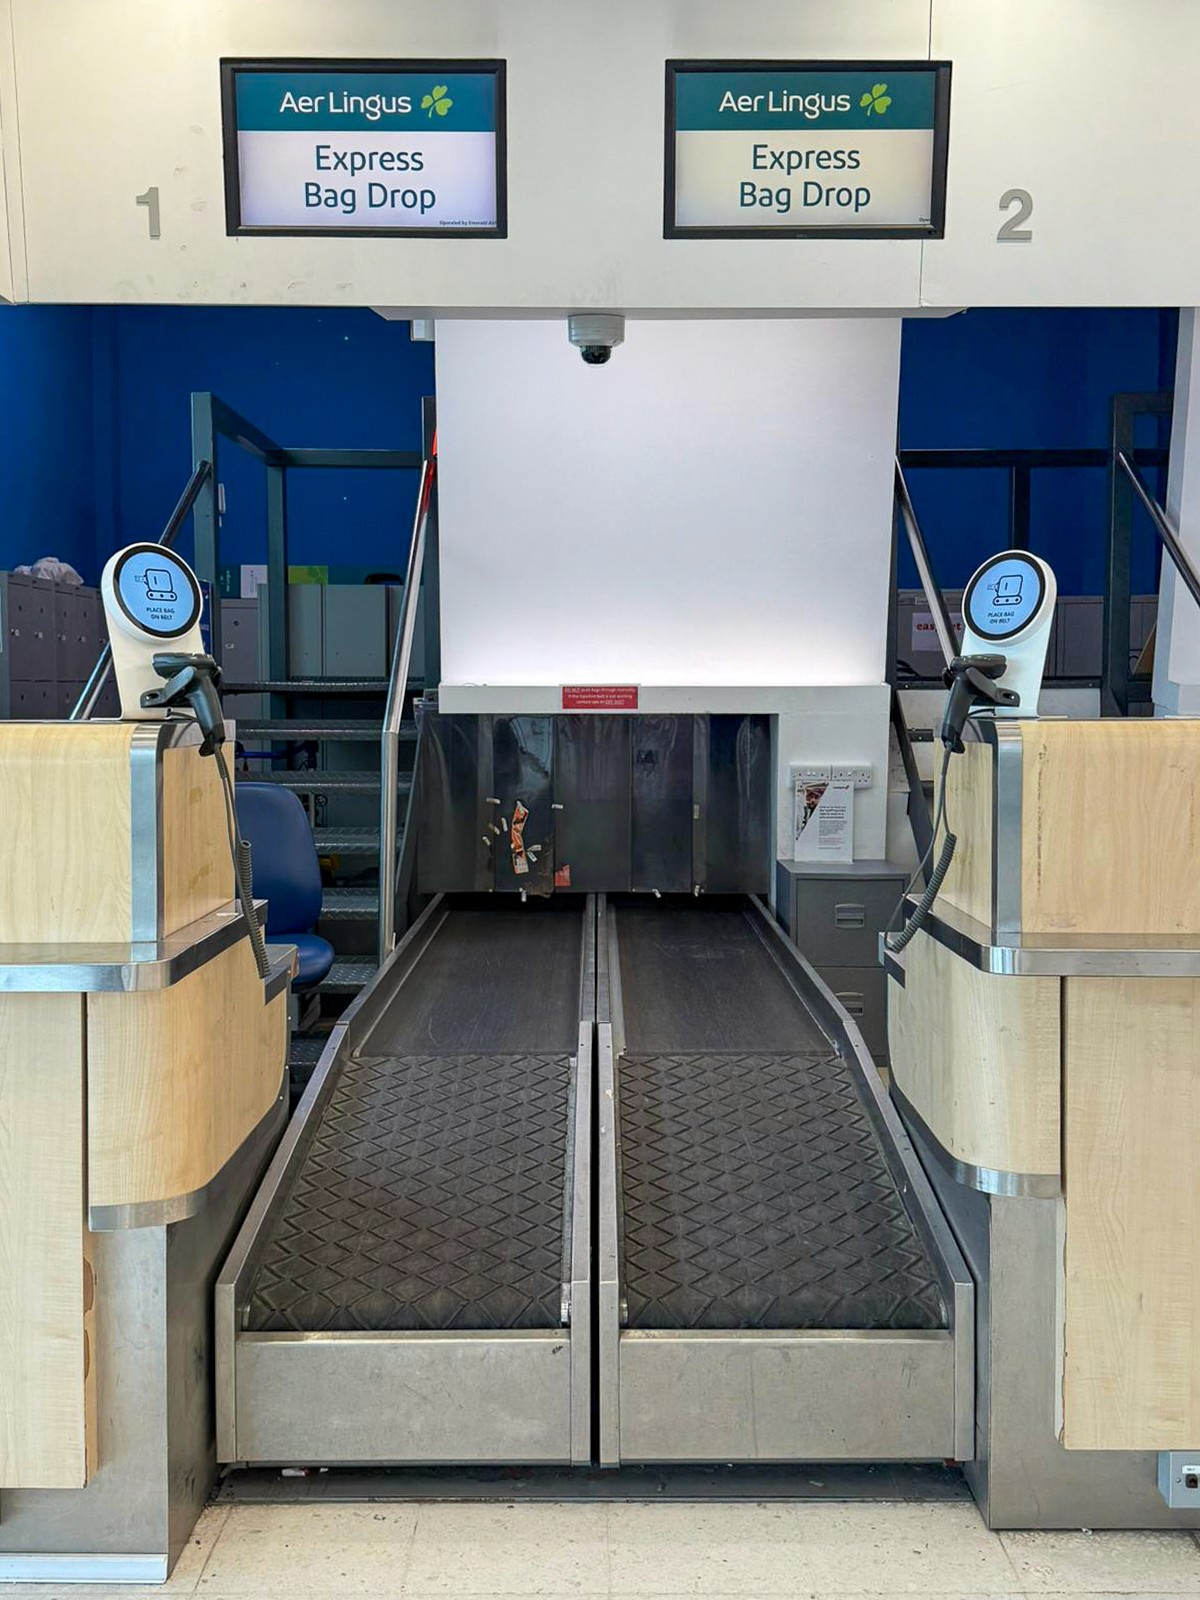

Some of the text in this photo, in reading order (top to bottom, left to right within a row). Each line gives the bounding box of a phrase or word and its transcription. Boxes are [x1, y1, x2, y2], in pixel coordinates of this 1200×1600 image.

[279, 91, 412, 121] Aer Lingus
[718, 90, 851, 119] Aer Lingus
[315, 145, 424, 177] Express
[752, 144, 861, 175] Express
[136, 186, 161, 240] 1
[305, 182, 436, 214] Bag Drop
[739, 181, 871, 213] Bag Drop
[997, 188, 1033, 243] 2
